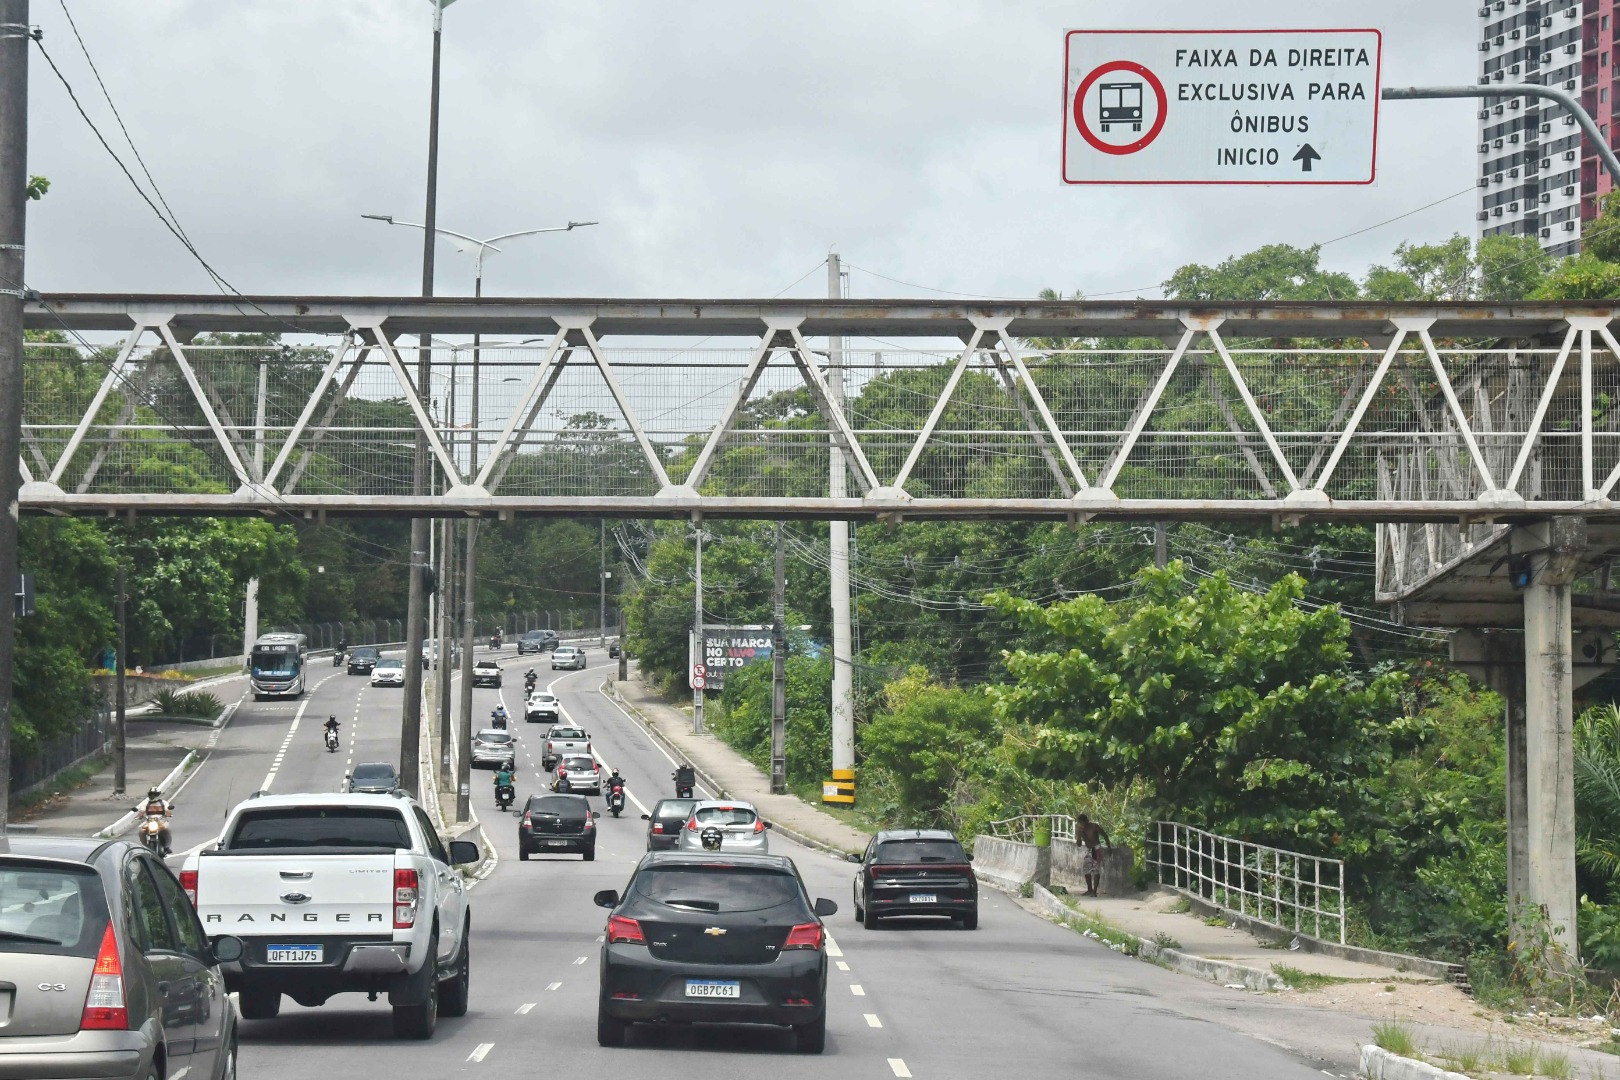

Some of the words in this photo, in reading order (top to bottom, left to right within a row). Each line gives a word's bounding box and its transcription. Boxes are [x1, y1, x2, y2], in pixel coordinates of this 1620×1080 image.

[1175, 49, 1238, 67] FAIXA
[1249, 49, 1278, 67] DA
[1288, 48, 1370, 67] DIREITA
[1178, 83, 1295, 101] EXCLUSIVA
[1308, 82, 1366, 100] PARA
[1230, 109, 1309, 133] ÔNIBUS
[1217, 148, 1279, 165] INICIO
[706, 638, 729, 647] SUA
[731, 638, 772, 648] MARCA
[706, 648, 723, 657] NO
[726, 648, 756, 657] ALVO
[706, 657, 744, 667] CERTO
[206, 913, 383, 922] RANGER
[272, 950, 317, 961] QFT1J75
[37, 982, 67, 991] C3
